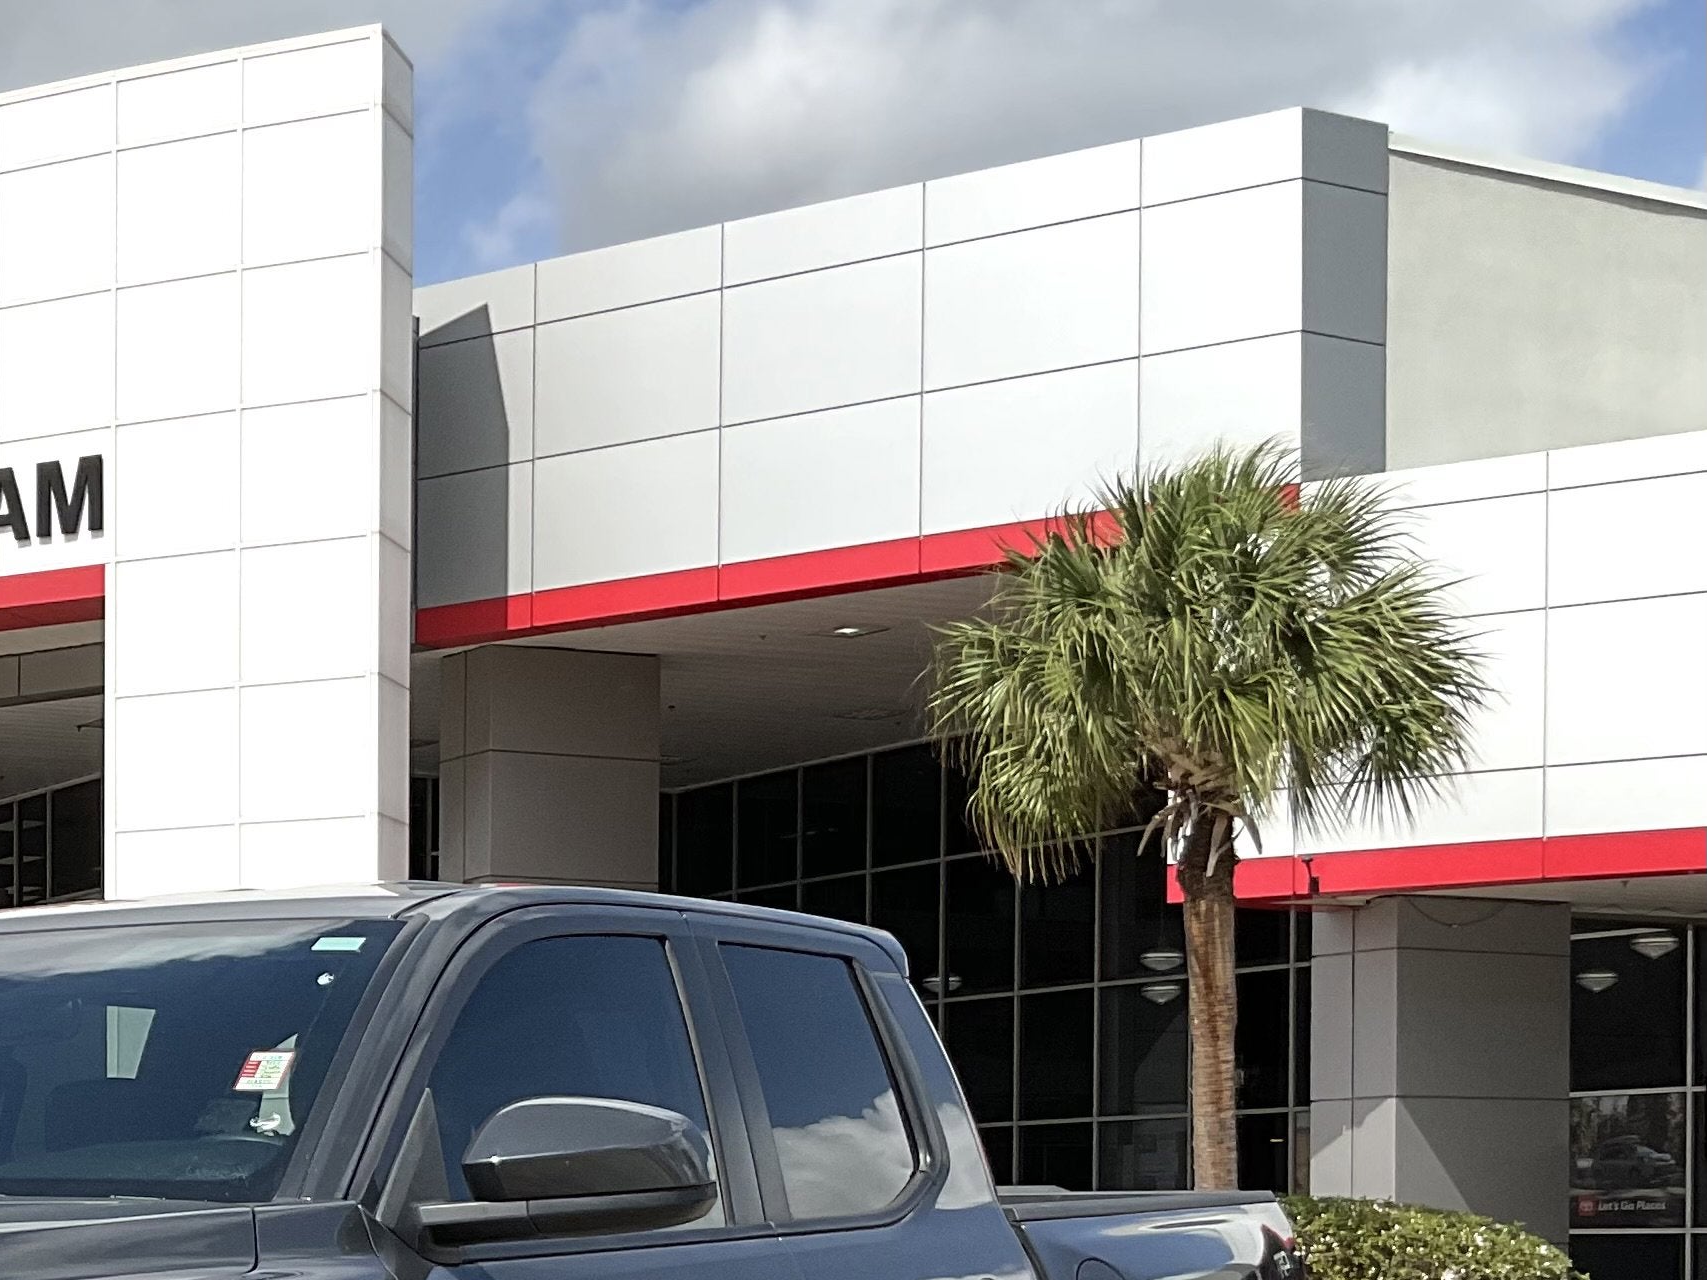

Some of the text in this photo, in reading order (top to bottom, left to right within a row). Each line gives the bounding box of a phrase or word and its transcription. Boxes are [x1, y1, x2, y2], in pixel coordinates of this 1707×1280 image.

[1598, 1201, 1667, 1211] Let's Go Places
